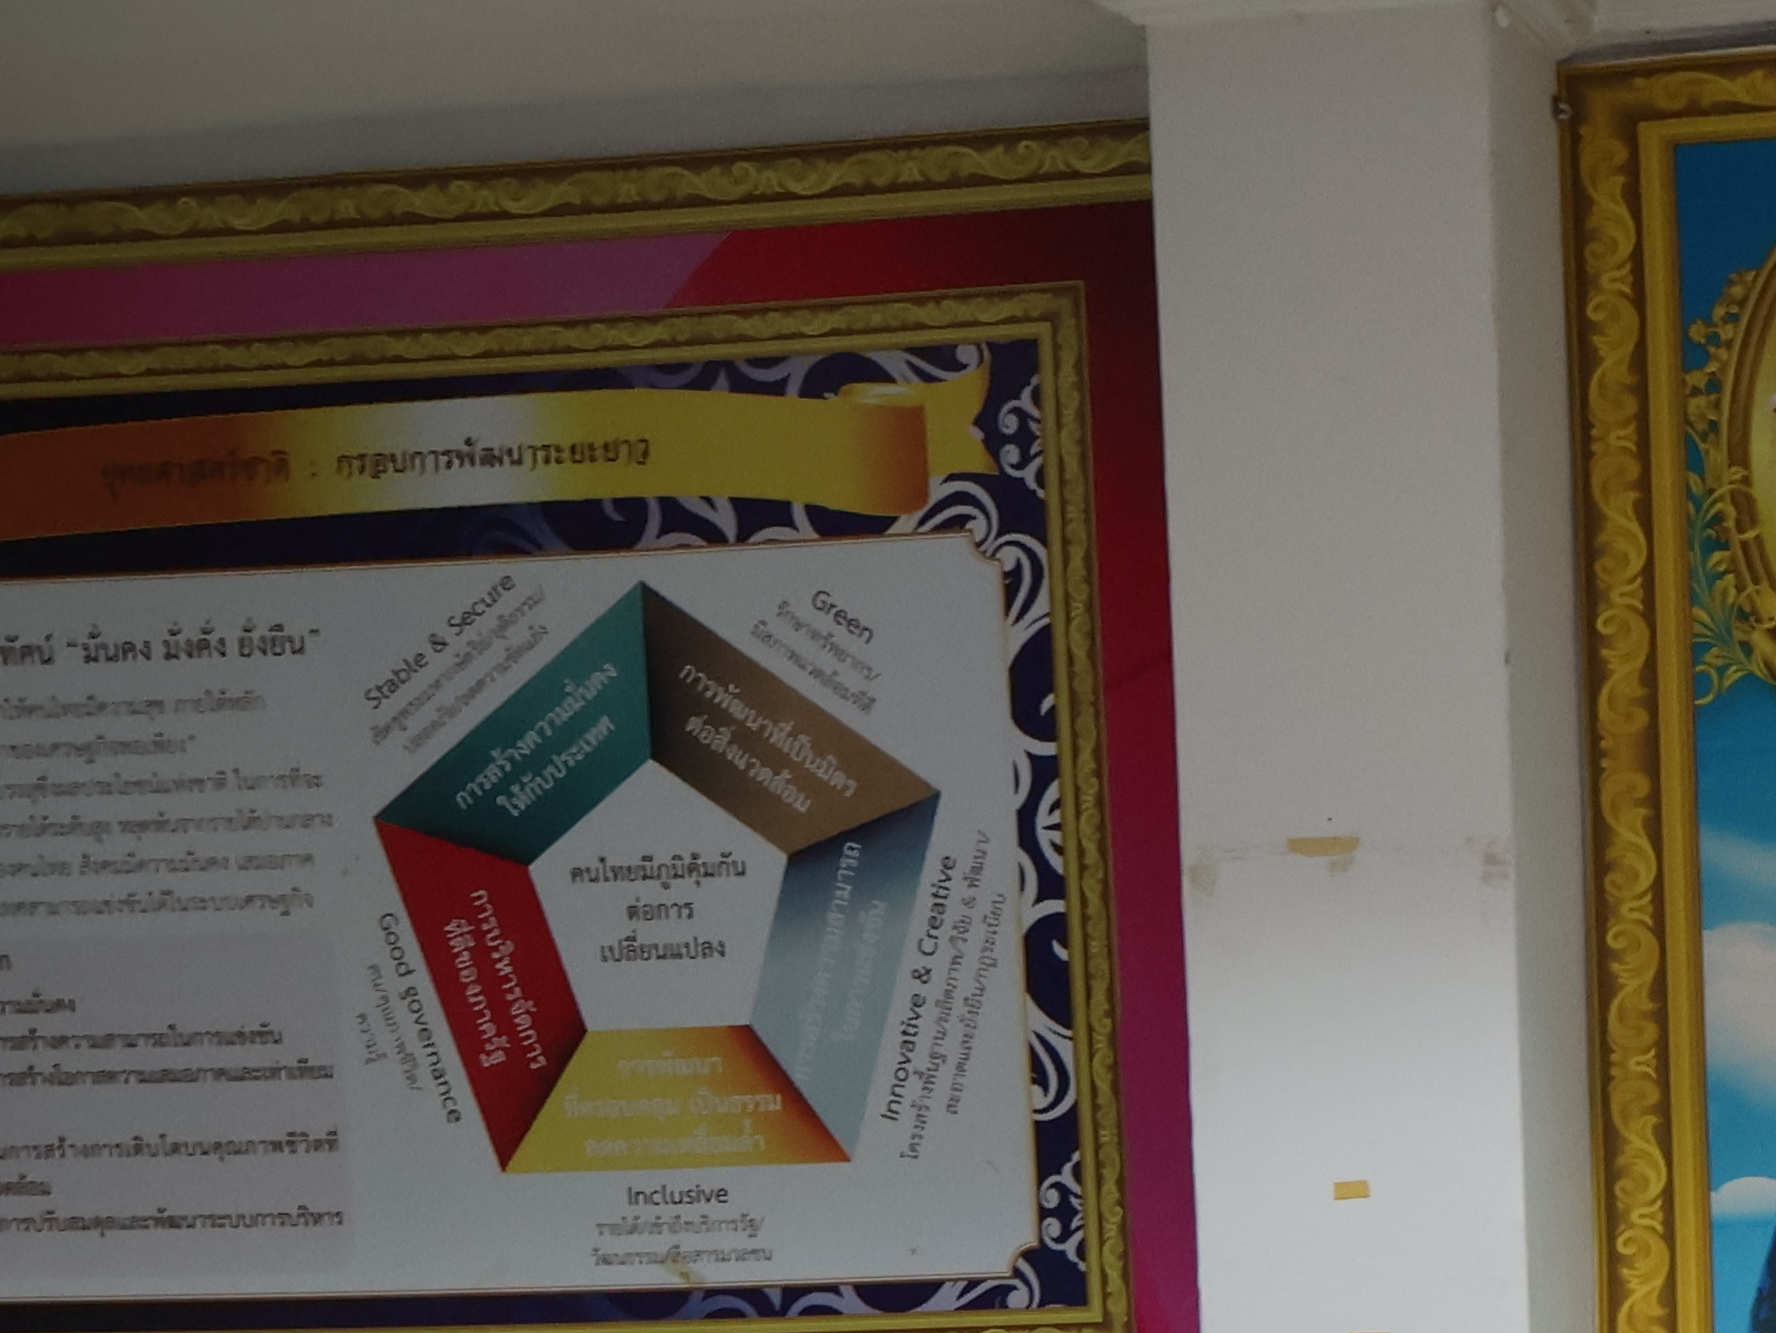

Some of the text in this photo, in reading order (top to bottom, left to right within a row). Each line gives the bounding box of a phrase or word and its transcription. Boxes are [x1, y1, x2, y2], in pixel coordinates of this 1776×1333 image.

[363, 652, 428, 711] Stable
[447, 572, 517, 635] Secure
[810, 588, 875, 645] Green
[627, 897, 696, 923] ต่อการ
[377, 913, 462, 1125] Good governance
[469, 888, 548, 1072] การบริหารจัดการ
[881, 988, 930, 1124] Innovative
[916, 854, 957, 959] Creative
[627, 1183, 729, 1207] Inclusive
